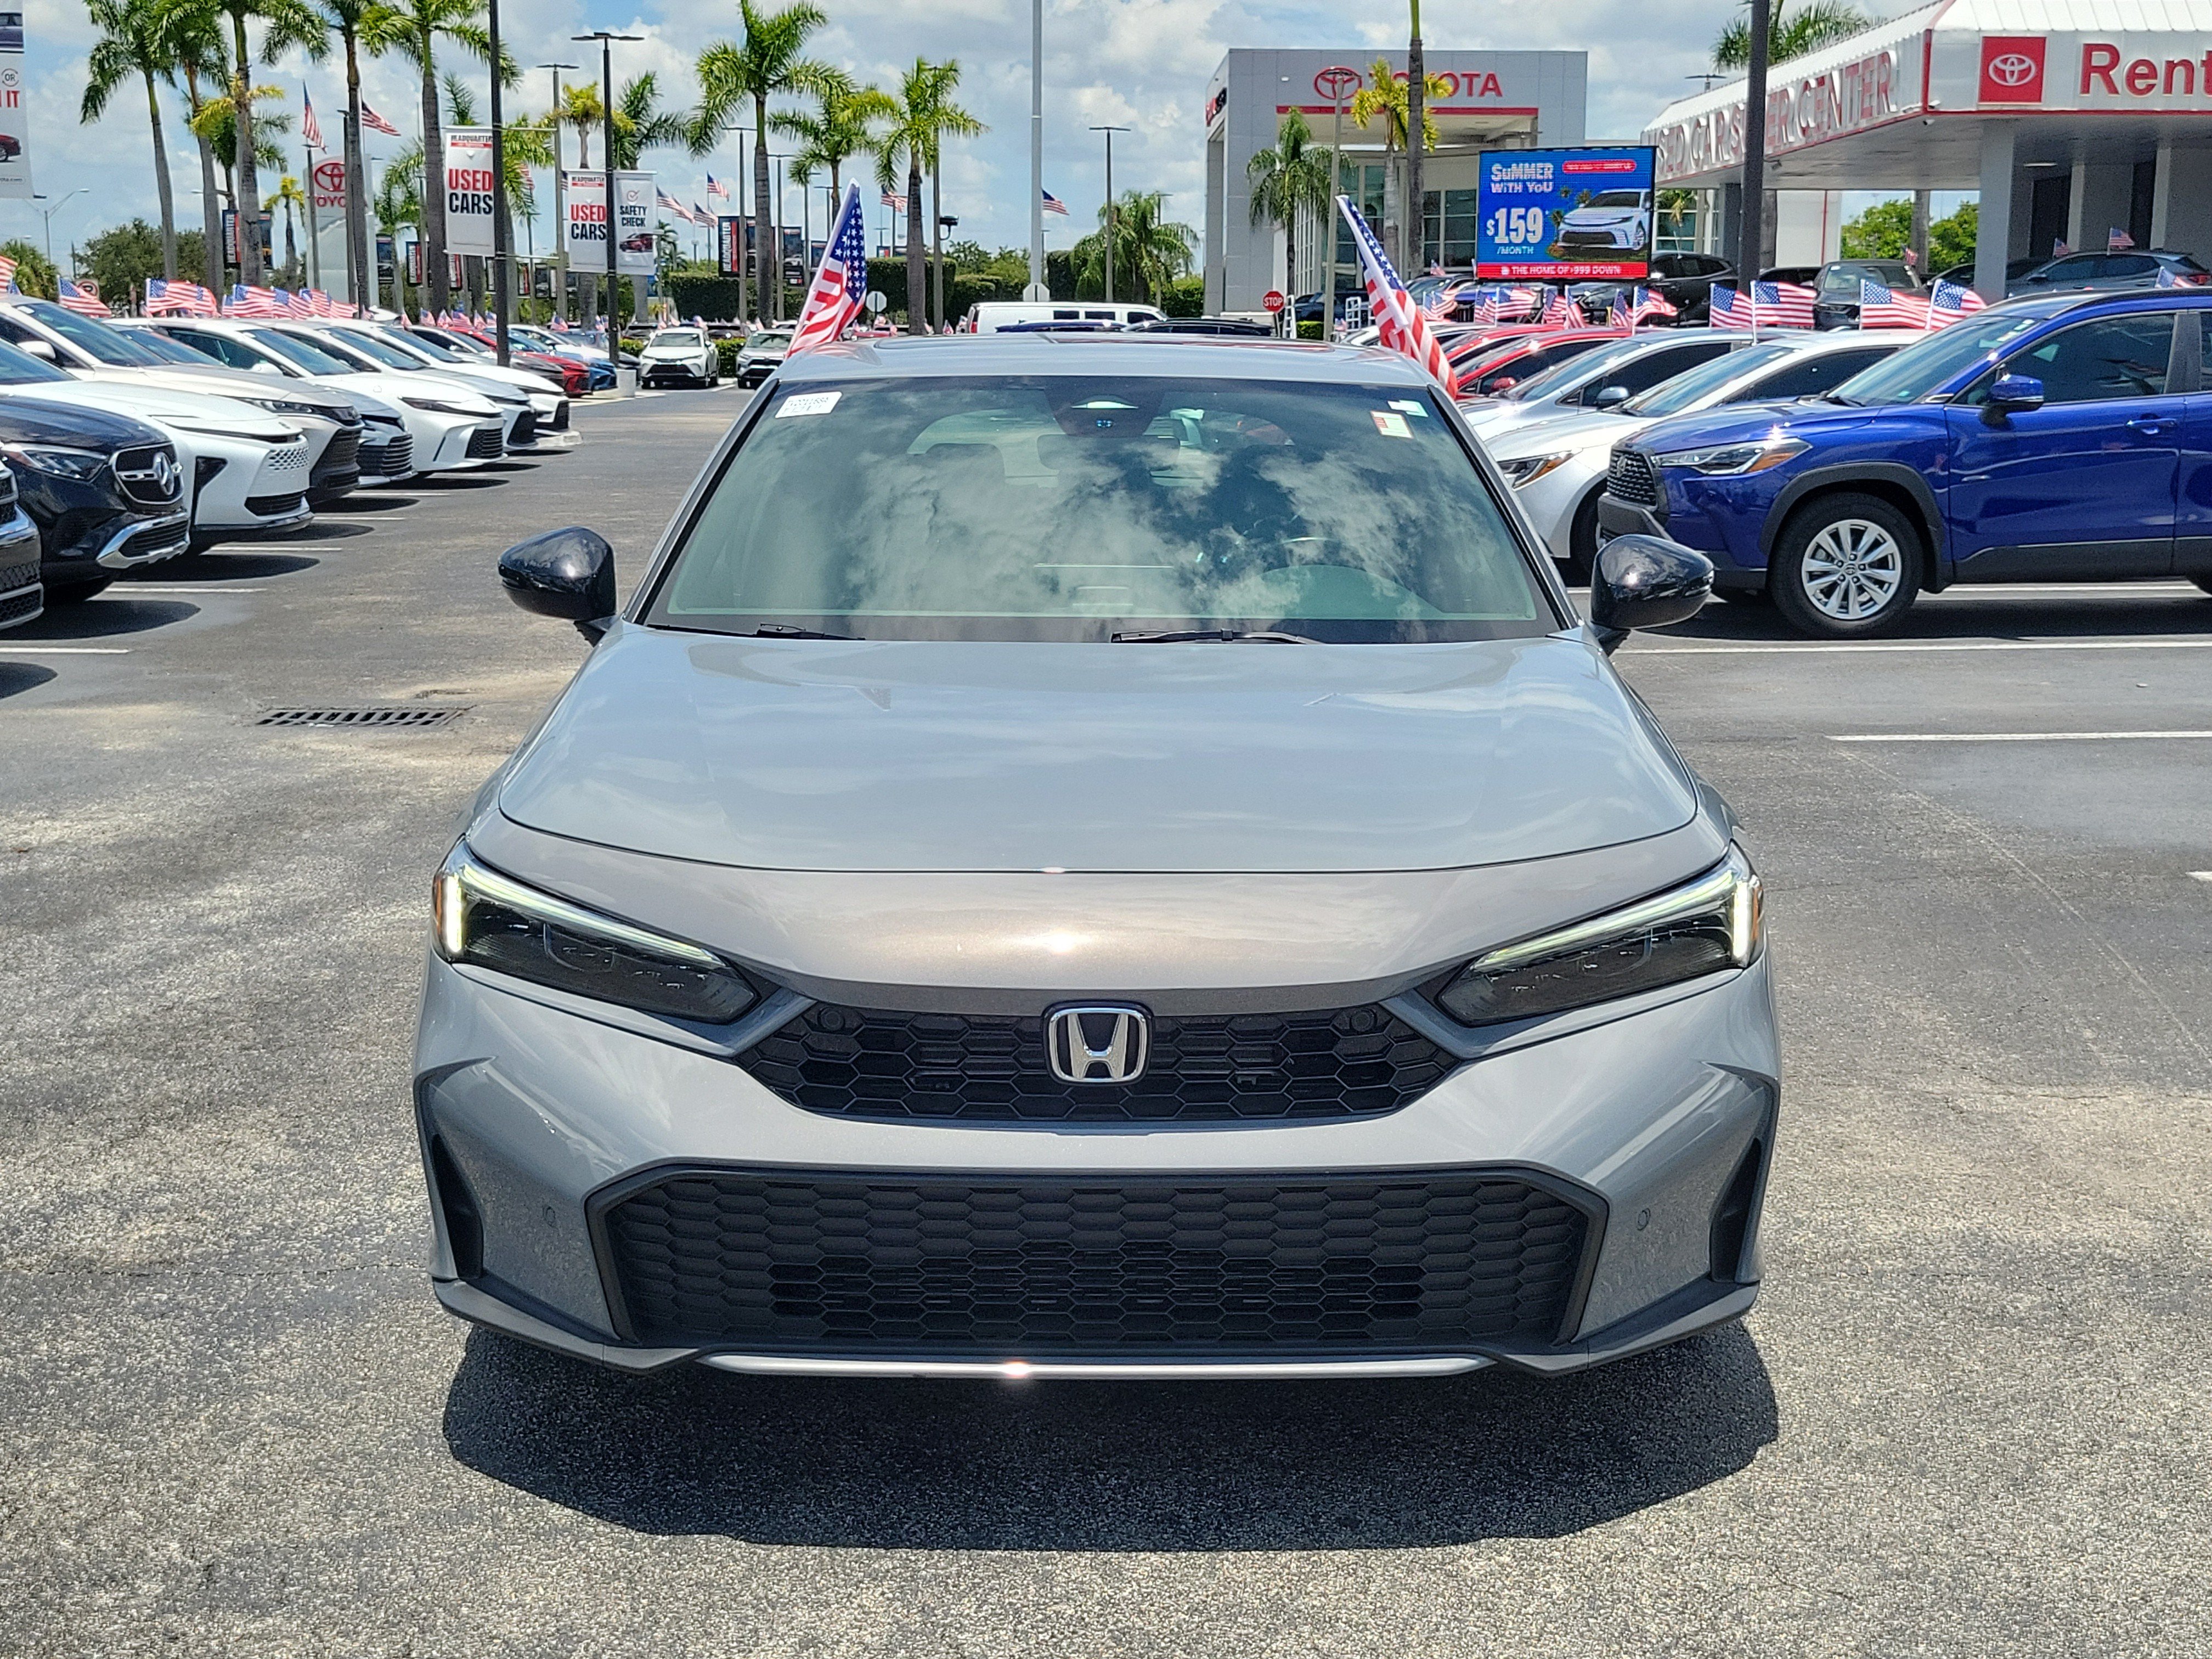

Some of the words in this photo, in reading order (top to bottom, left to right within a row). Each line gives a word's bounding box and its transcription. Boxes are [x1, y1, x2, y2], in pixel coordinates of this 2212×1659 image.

[449, 168, 493, 192] USED
[449, 193, 493, 215] CARS
[619, 205, 647, 216] SAFETY
[571, 204, 606, 222] USED
[622, 217, 646, 227] CHECK
[571, 223, 606, 240] CARS
[1511, 266, 1528, 274] THE
[1530, 266, 1555, 274] HOME
[1557, 266, 1570, 274] OF
[1592, 266, 1621, 274] DOWN
[1263, 297, 1283, 307] STOP
